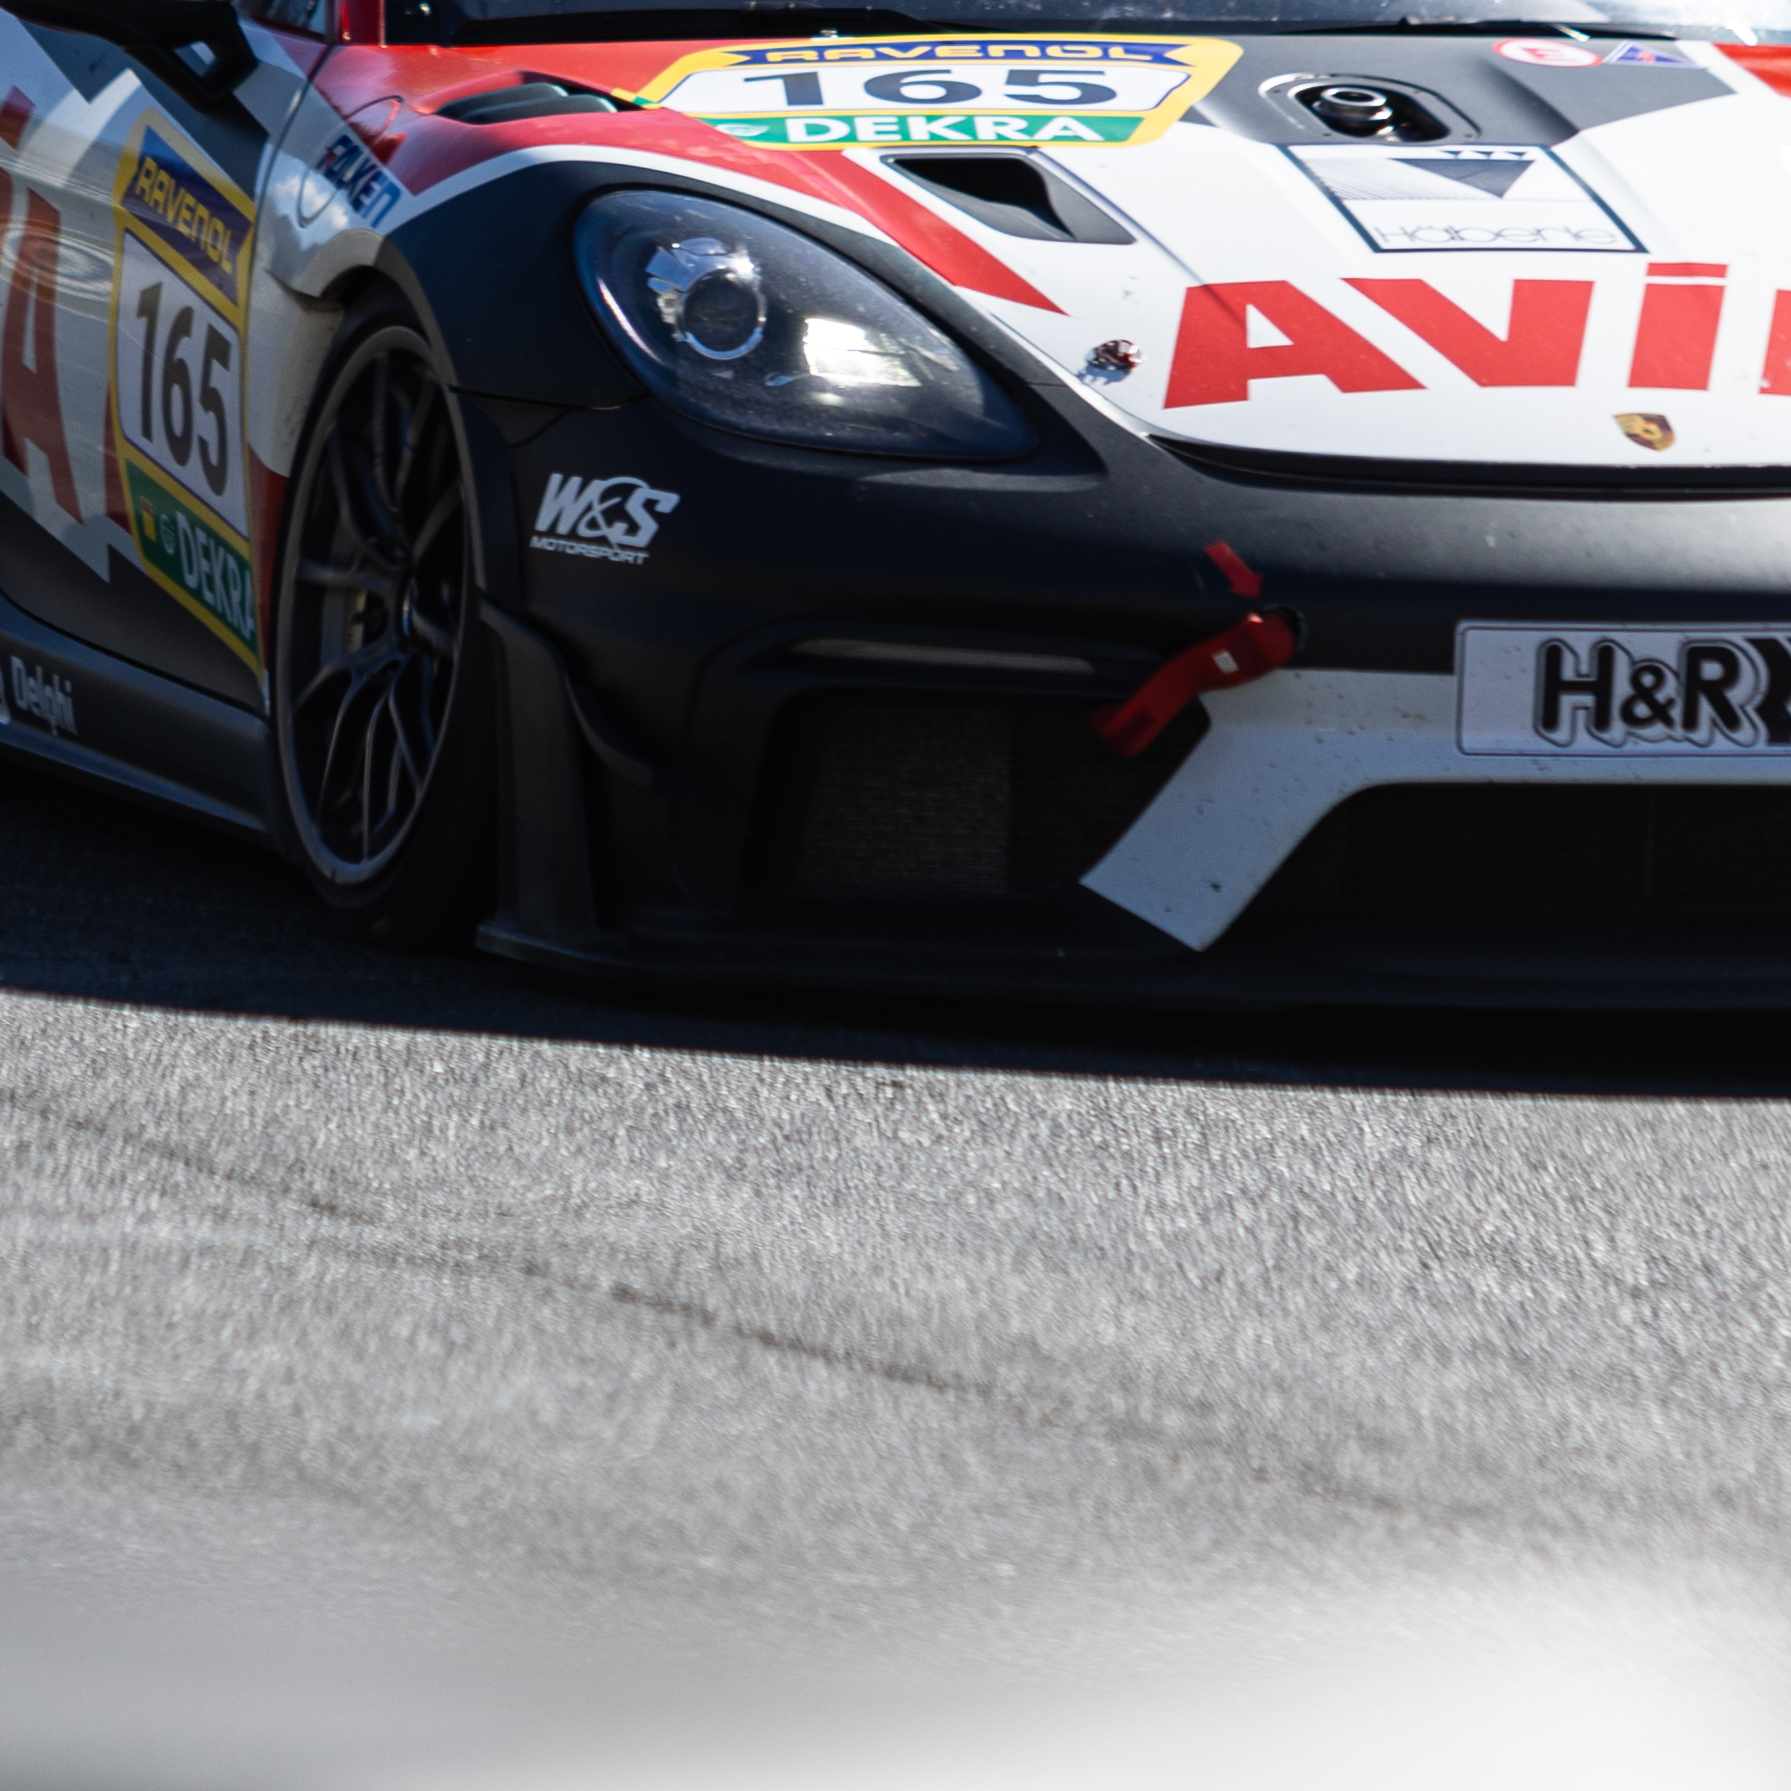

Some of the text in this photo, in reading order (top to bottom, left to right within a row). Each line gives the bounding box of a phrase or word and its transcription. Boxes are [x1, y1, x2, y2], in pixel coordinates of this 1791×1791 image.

[744, 69, 1118, 107] 165
[765, 44, 1154, 63] RAVENOL
[785, 115, 1105, 142] DEKRA
[135, 155, 233, 275] RAVENOL
[316, 134, 401, 229] FALKEN
[135, 282, 234, 498] 165
[534, 472, 681, 549] W&S
[175, 510, 256, 641] DEKRA
[529, 536, 650, 566] MOTORSPORT
[9, 654, 79, 737] Delphi
